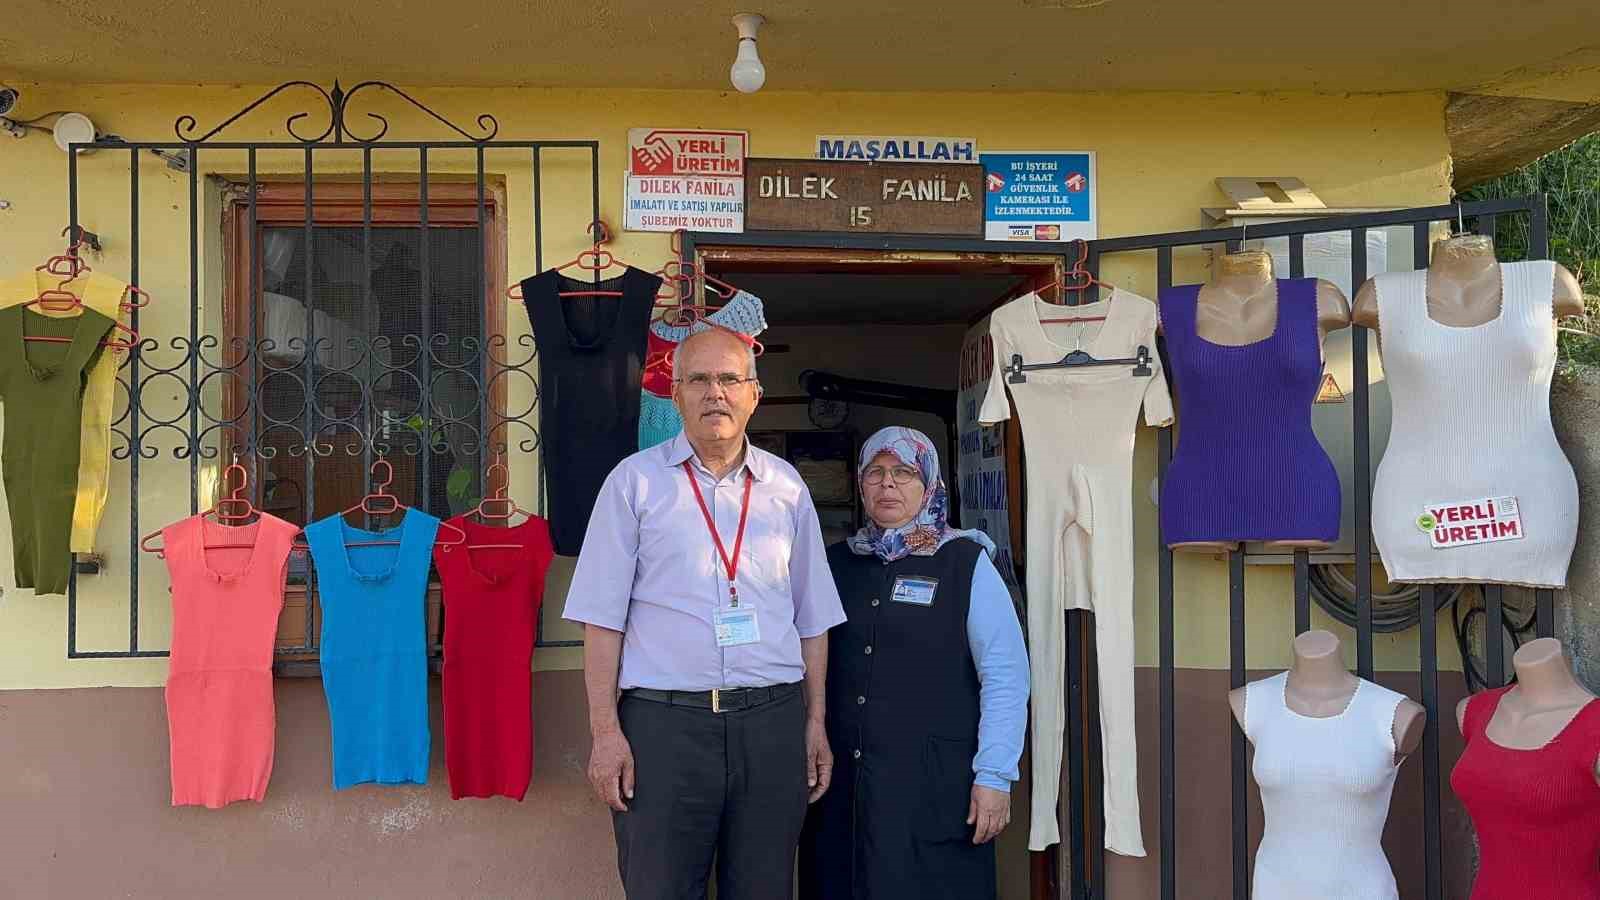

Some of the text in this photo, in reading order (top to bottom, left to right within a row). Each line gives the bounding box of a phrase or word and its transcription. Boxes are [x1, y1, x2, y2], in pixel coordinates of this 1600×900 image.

[677, 138, 725, 153] YERLİ
[819, 140, 973, 161] MAŞALLAH
[676, 154, 740, 172] ÜRETİM
[1011, 160, 1058, 172] BU İŞYERİ
[759, 169, 973, 202] DİLEK FANİLA
[1015, 174, 1054, 182] 24 SAAT
[686, 178, 736, 197] FANİLA
[668, 200, 679, 211] VE
[681, 200, 709, 214] SATIŞI
[710, 202, 743, 213] YAPILIR
[1000, 195, 1051, 204] KAMERASI
[641, 214, 733, 228] ŞUBEMİZ YOKTUR
[850, 206, 873, 227] 15
[1430, 499, 1495, 524] YERLİ
[1434, 519, 1518, 544] ÜRETİM
